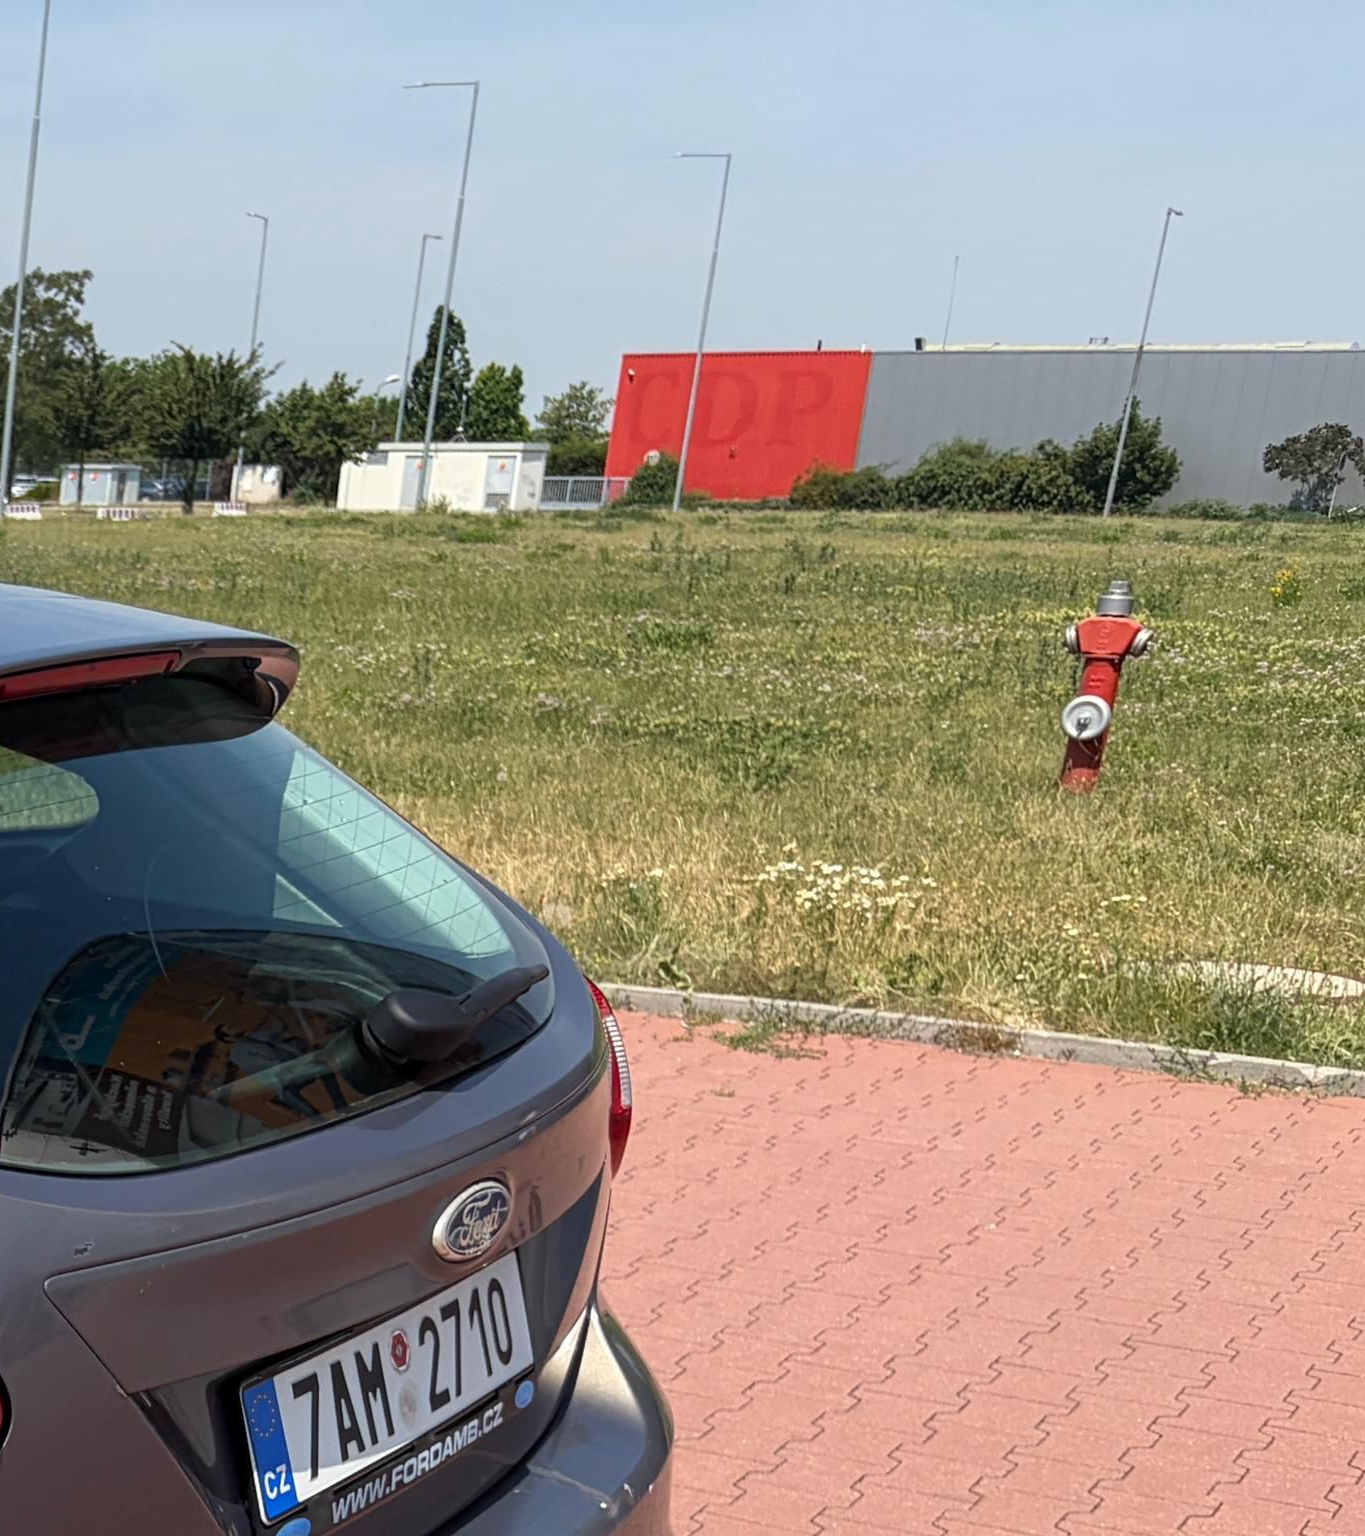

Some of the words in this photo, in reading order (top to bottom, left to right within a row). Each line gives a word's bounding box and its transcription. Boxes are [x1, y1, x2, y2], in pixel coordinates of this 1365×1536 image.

[449, 1193, 509, 1247] Ford
[291, 1342, 395, 1482] 7AM
[419, 1277, 513, 1413] 2710
[264, 1463, 291, 1500] CZ
[332, 1402, 504, 1524] WWW.FORDAMB.CZ
